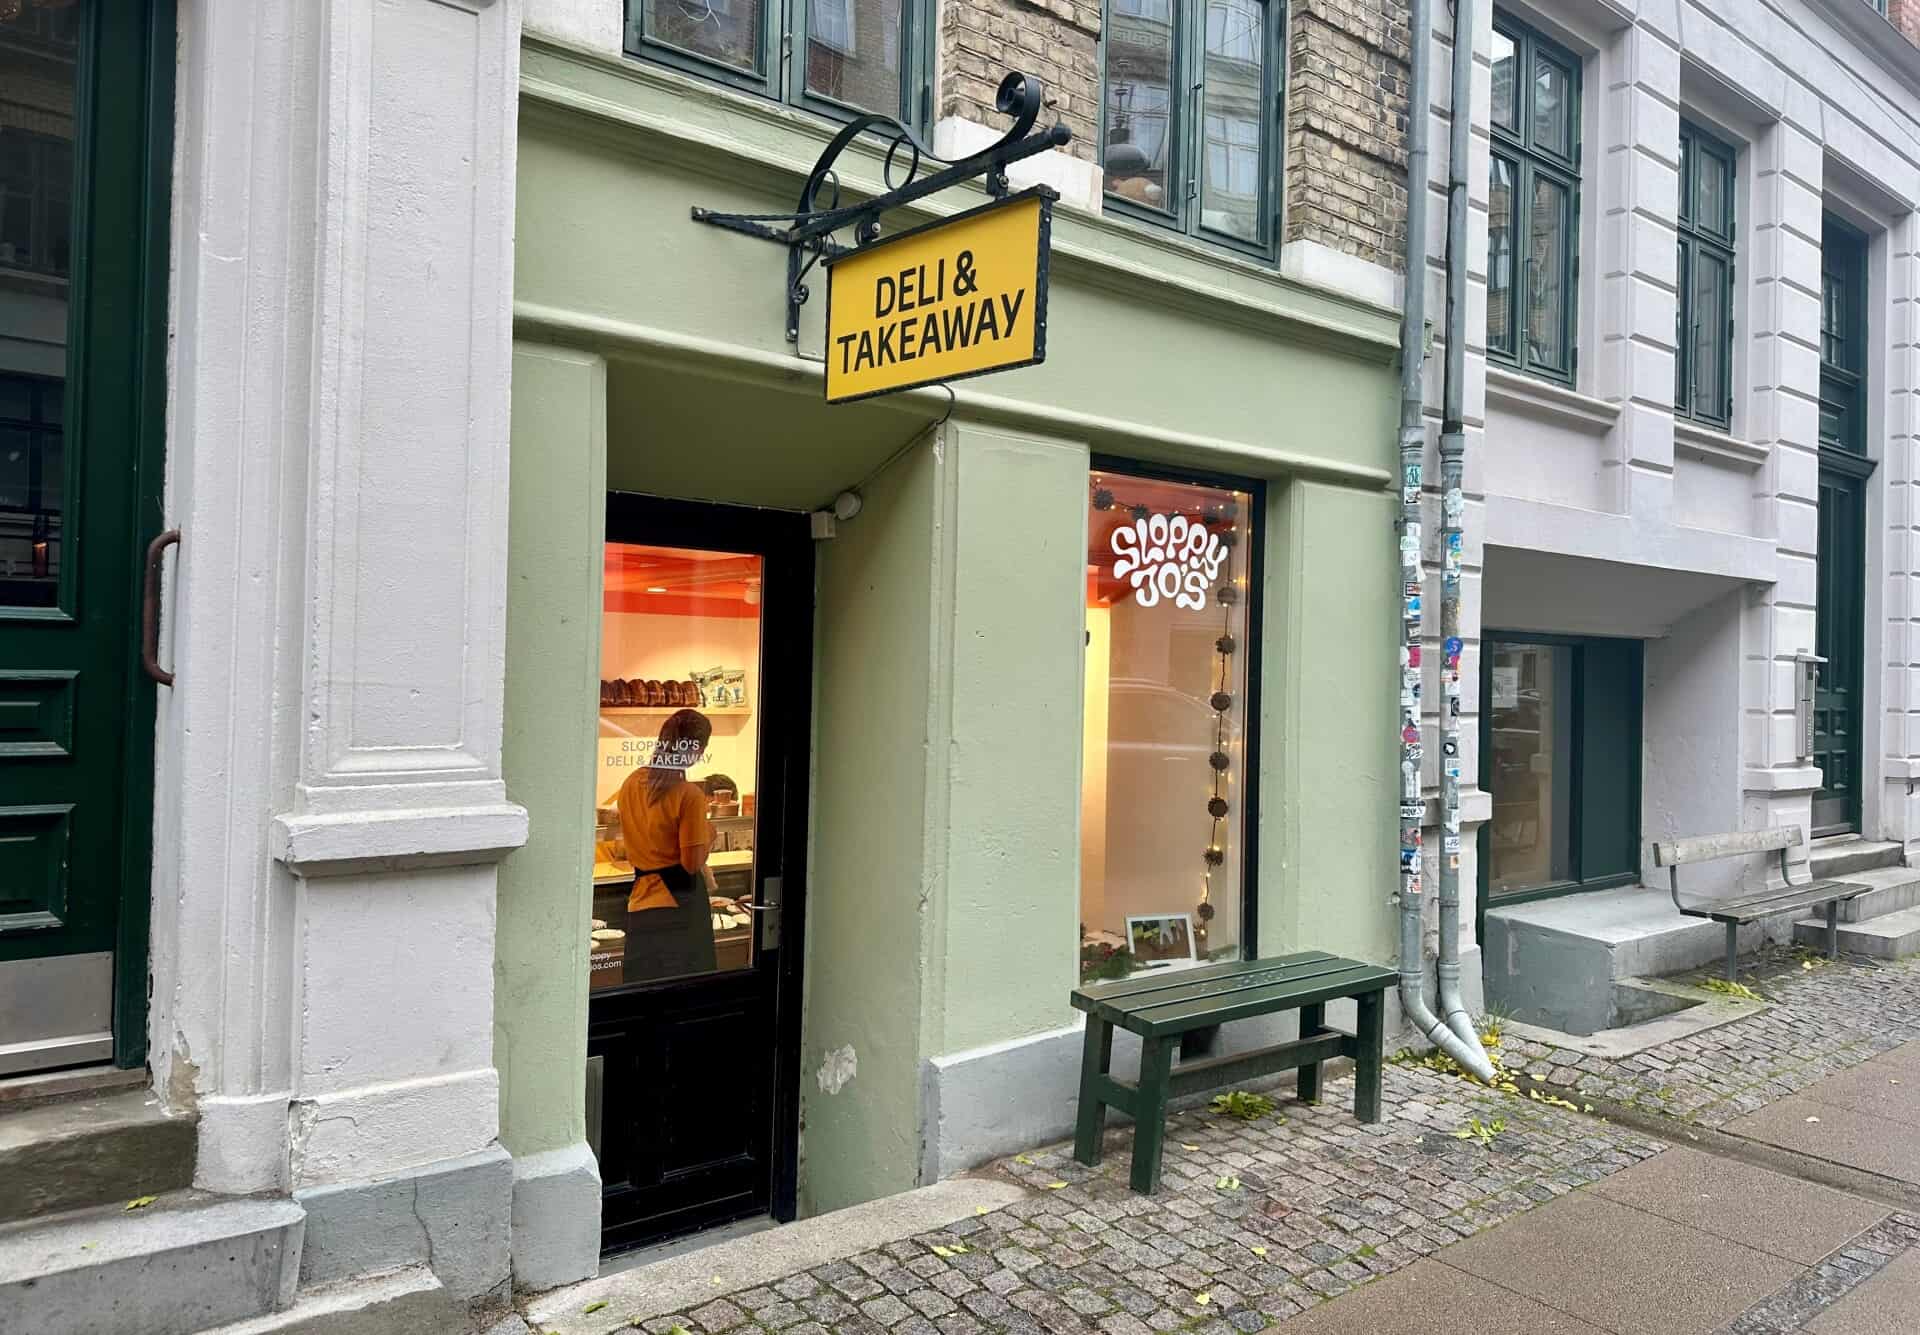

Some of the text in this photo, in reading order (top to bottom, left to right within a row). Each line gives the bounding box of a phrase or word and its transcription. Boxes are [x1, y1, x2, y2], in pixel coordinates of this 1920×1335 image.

[876, 250, 978, 318] DELI &
[837, 288, 1025, 374] TAKEAWAY
[1111, 513, 1229, 580] SLOPPY
[606, 753, 712, 767] DELI & TAKEAWAY
[623, 739, 700, 752] SLOPPY JO'S
[592, 960, 622, 970] os.com
